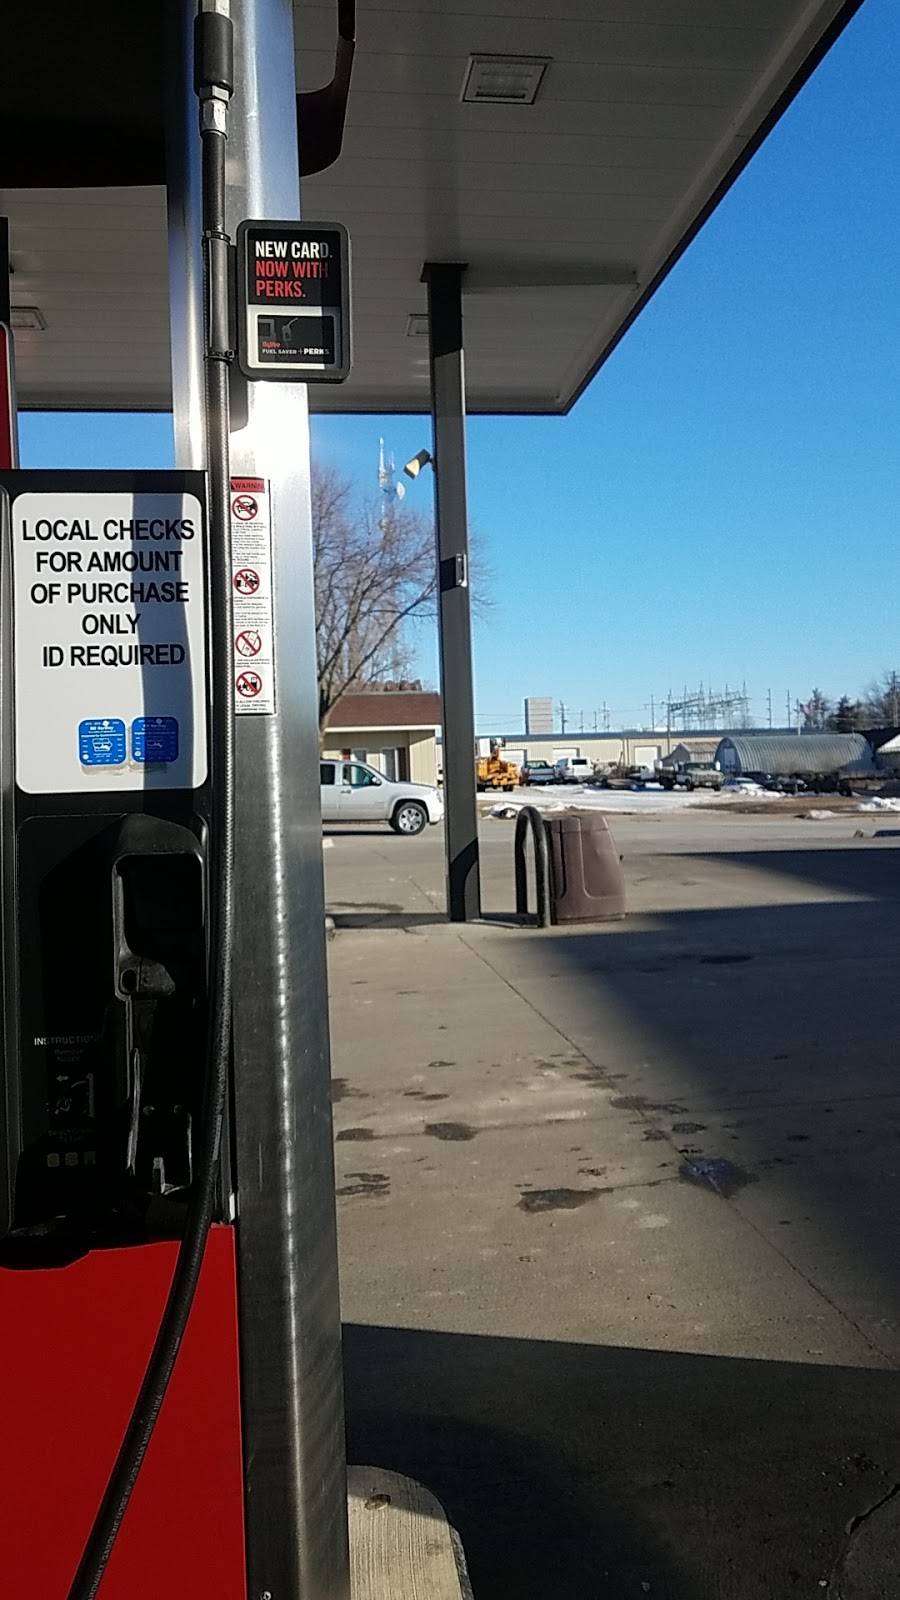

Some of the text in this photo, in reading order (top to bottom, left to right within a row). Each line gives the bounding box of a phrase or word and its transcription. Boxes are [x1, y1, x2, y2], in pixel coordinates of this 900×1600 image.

[255, 241, 333, 259] NEW CARD.
[255, 260, 328, 278] NOW WITH
[256, 280, 306, 297] PERKS.
[22, 519, 195, 541] LOCAL CHECKS
[36, 550, 183, 572] FOR AMOUNT
[30, 582, 190, 604] OF PURCHASE
[82, 613, 142, 635] ONLY
[43, 644, 185, 667] ID REQUIRED
